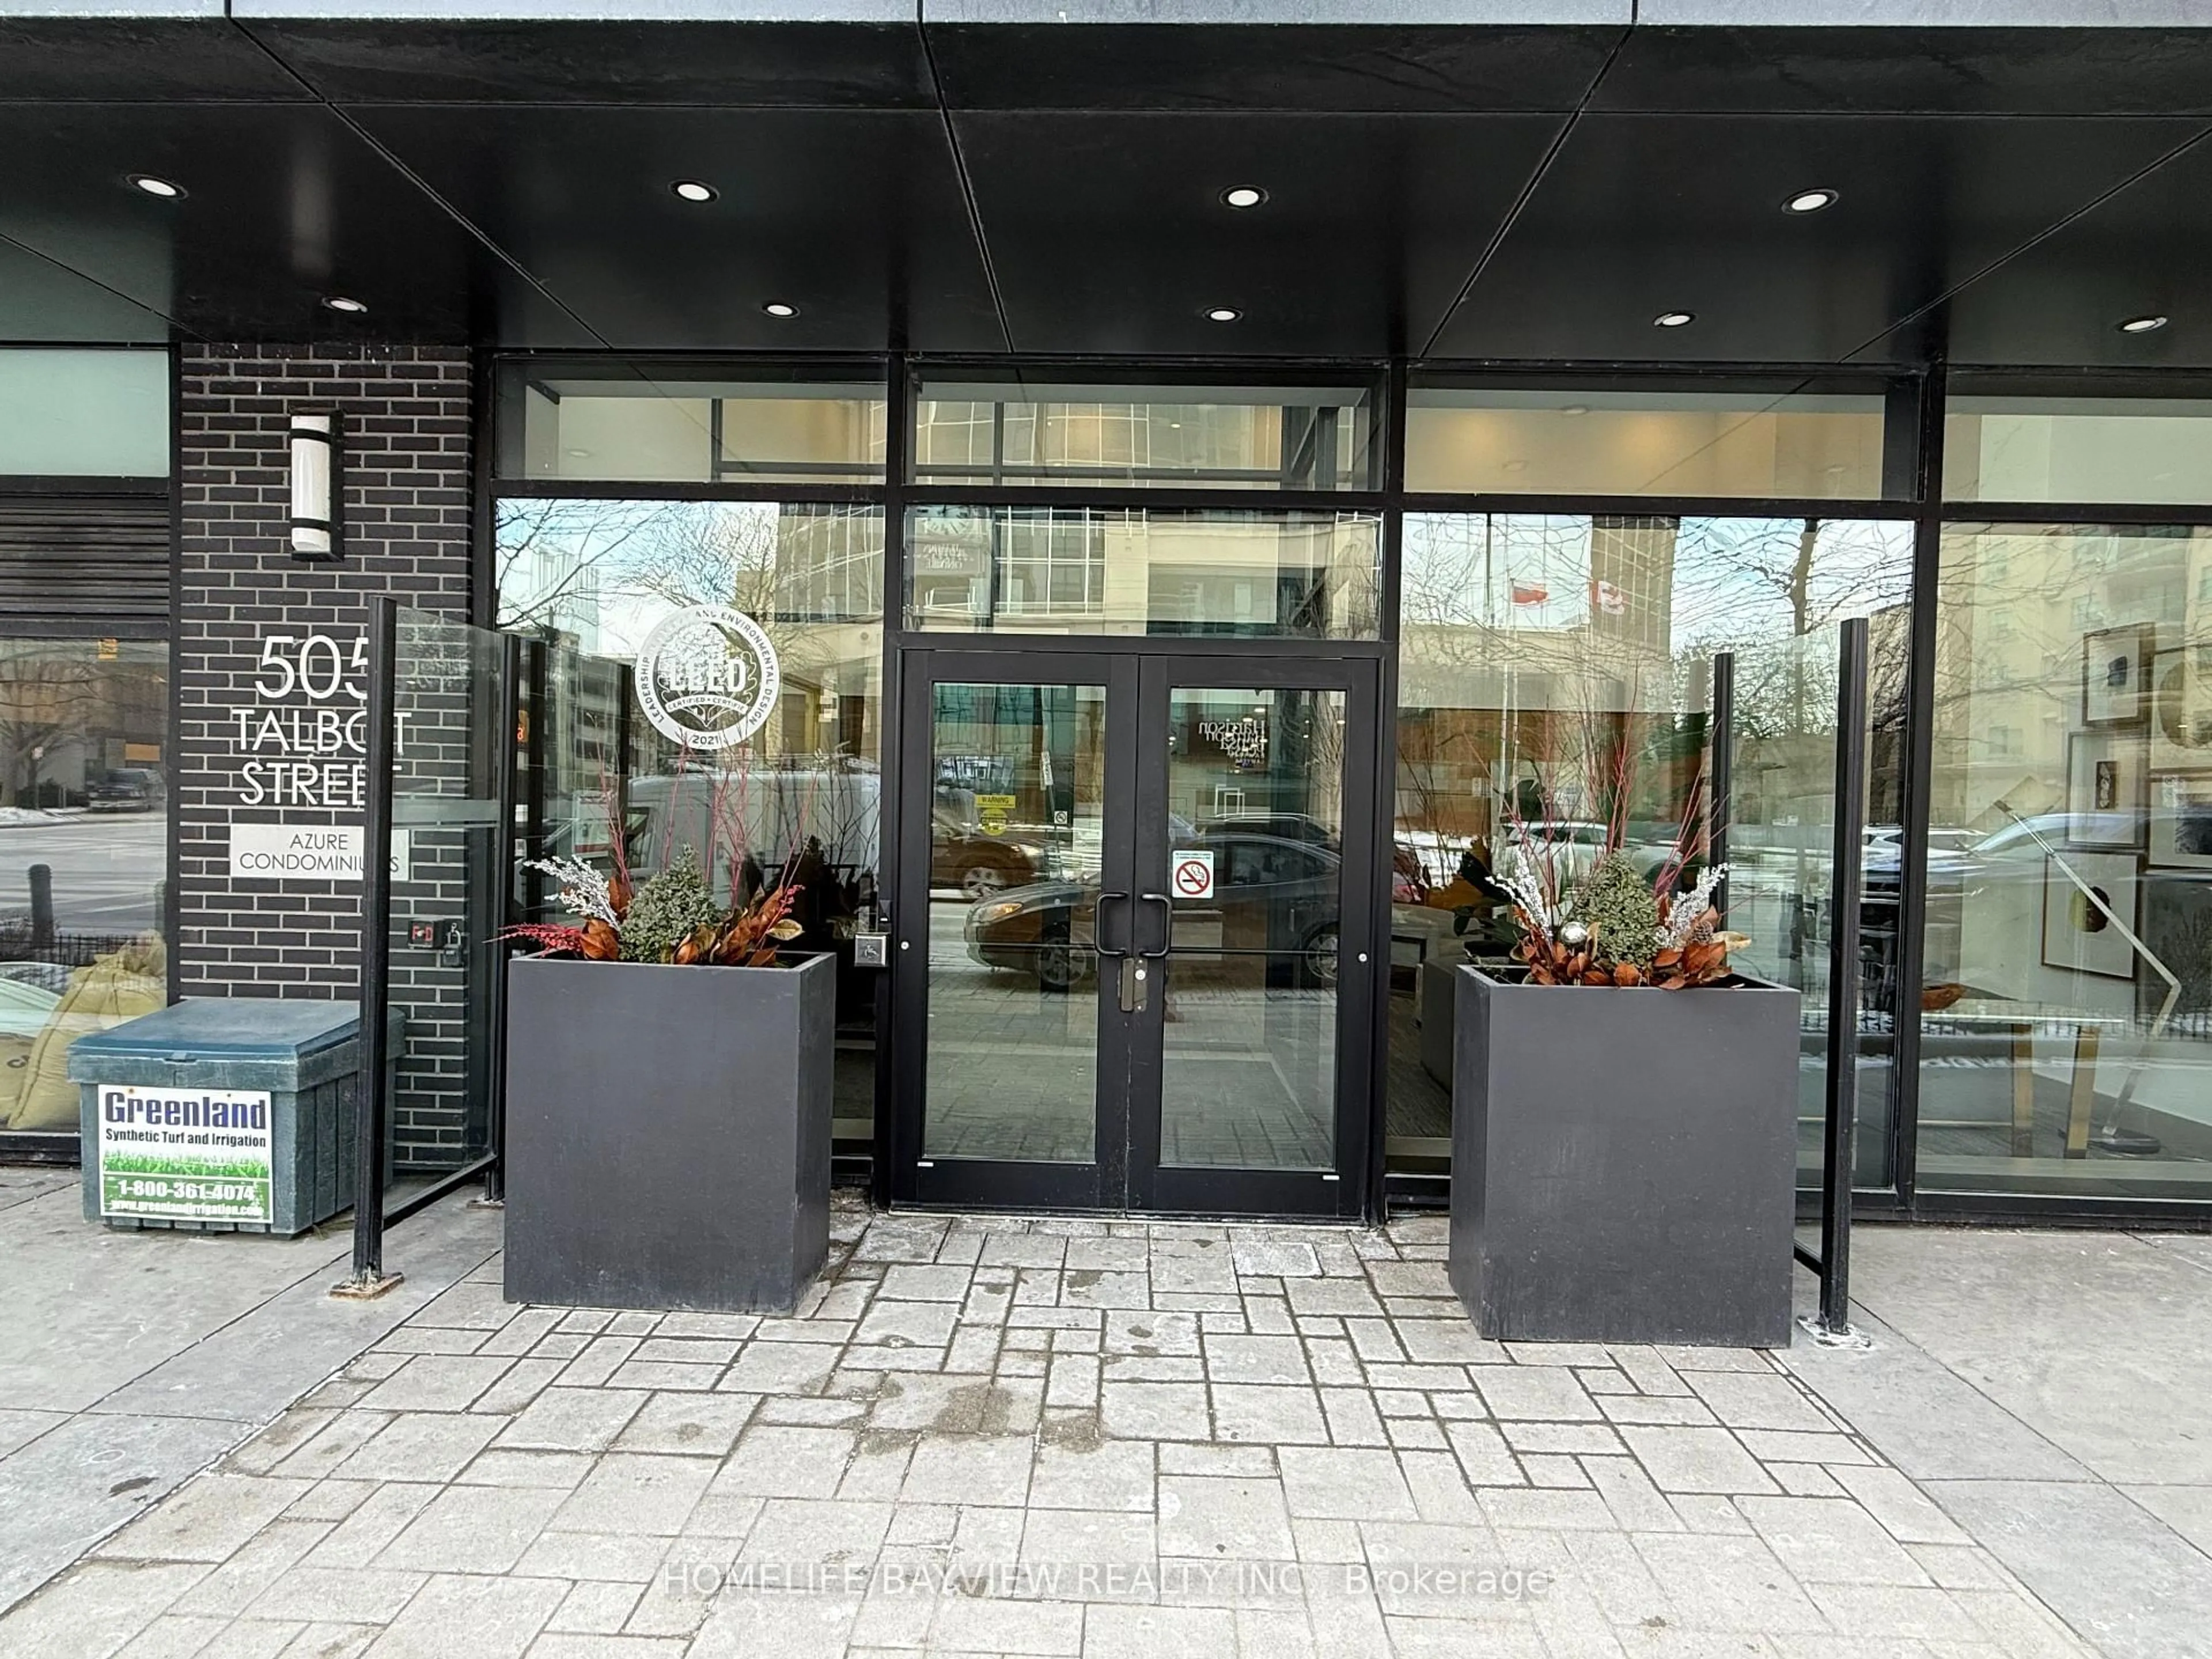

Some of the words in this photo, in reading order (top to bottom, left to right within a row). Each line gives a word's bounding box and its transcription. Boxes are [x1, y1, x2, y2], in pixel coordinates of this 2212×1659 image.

[668, 658, 747, 692] LEED
[721, 611, 774, 683] ENVIRONMENTAL
[749, 689, 772, 726] DESIGN
[642, 656, 665, 724] LEADERSHIP
[667, 696, 705, 710] CERTIFIED
[692, 734, 719, 745] 2021
[240, 761, 402, 806] STREE
[290, 834, 348, 850] AZURE
[105, 1092, 266, 1130] Greenland
[106, 1128, 160, 1143] Synthetic
[163, 1131, 184, 1144] Turf
[188, 1133, 209, 1145] and
[212, 1134, 266, 1147] Irrigation
[118, 1180, 256, 1200] 1-800-361-4074
